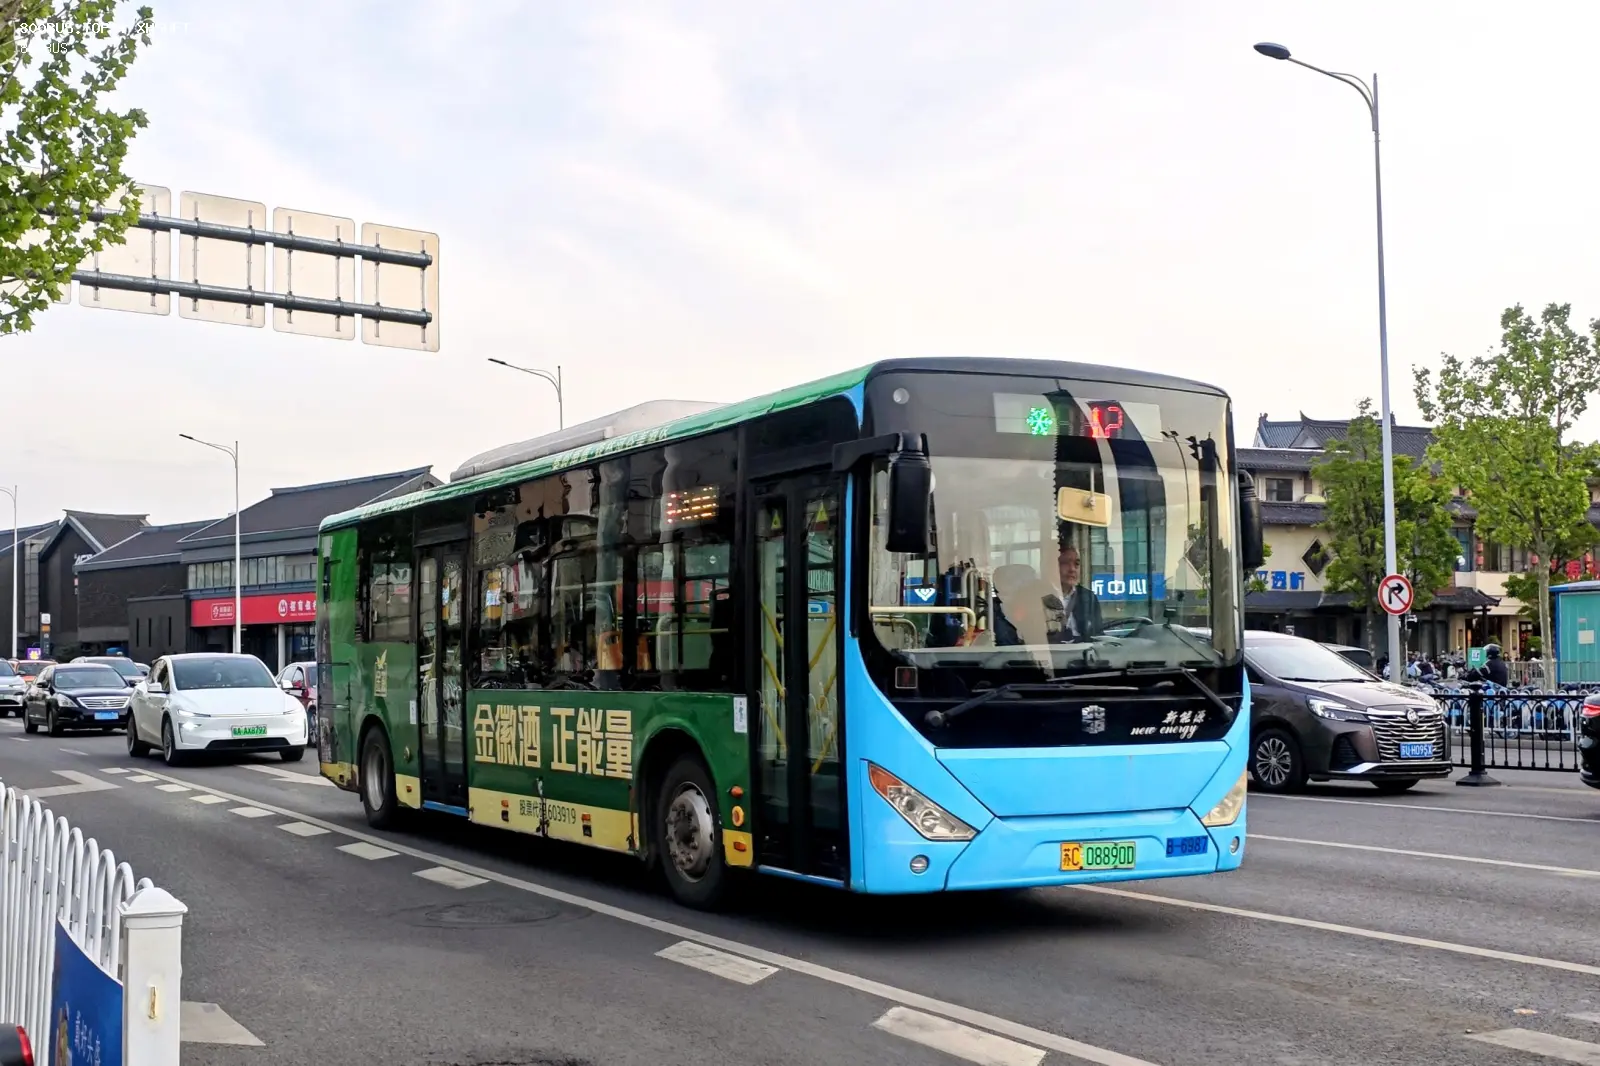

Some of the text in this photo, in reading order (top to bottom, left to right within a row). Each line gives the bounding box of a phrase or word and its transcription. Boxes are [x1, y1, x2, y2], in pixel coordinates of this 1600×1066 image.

[1162, 710, 1206, 725] 新能源
[1130, 724, 1198, 739] new energy
[474, 704, 633, 779] 金徽酒 正能量
